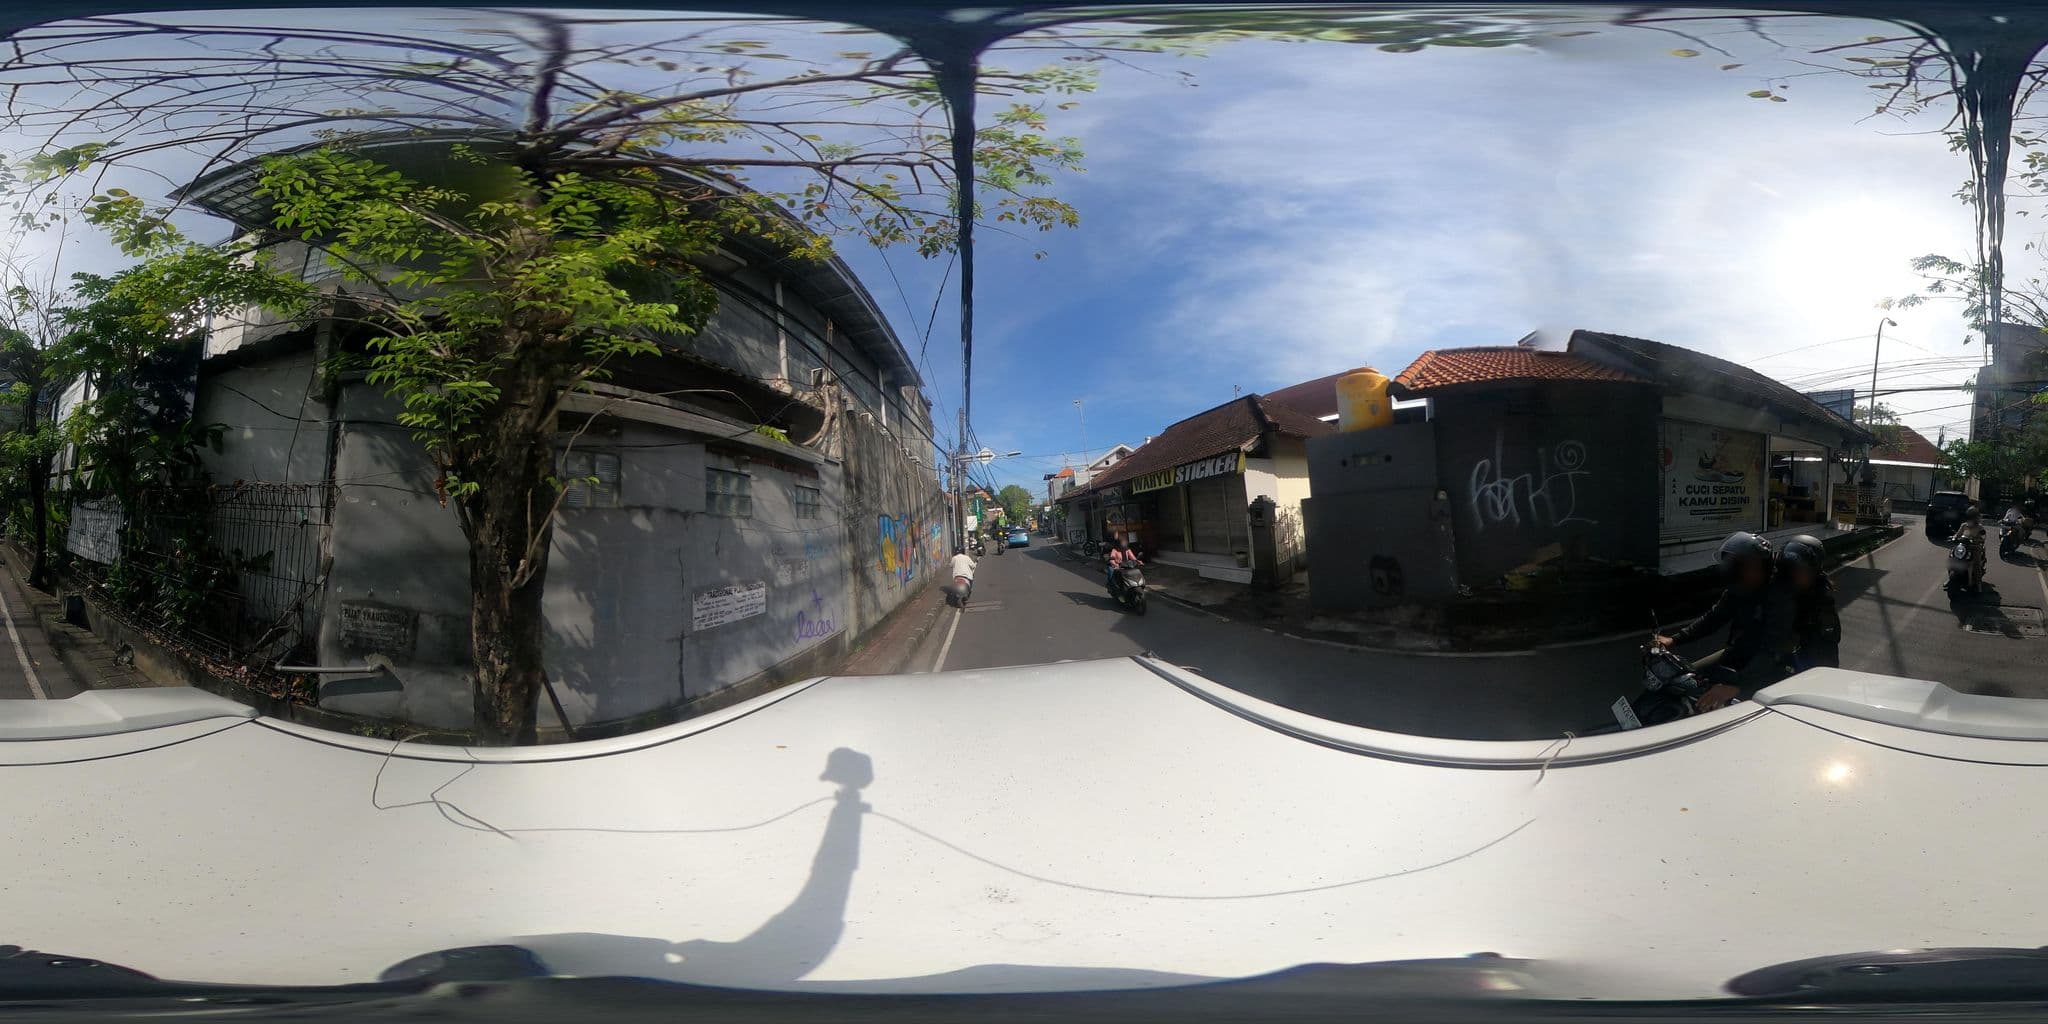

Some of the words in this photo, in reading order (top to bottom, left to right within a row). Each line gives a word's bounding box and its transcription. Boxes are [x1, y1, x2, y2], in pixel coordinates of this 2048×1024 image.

[1132, 469, 1172, 490] WAHYU
[1176, 452, 1238, 483] STICKER
[1685, 484, 1710, 495] CUCI
[1712, 485, 1746, 495] SEPATU
[1679, 496, 1717, 507] KAMU
[1720, 496, 1750, 505] DISINI
